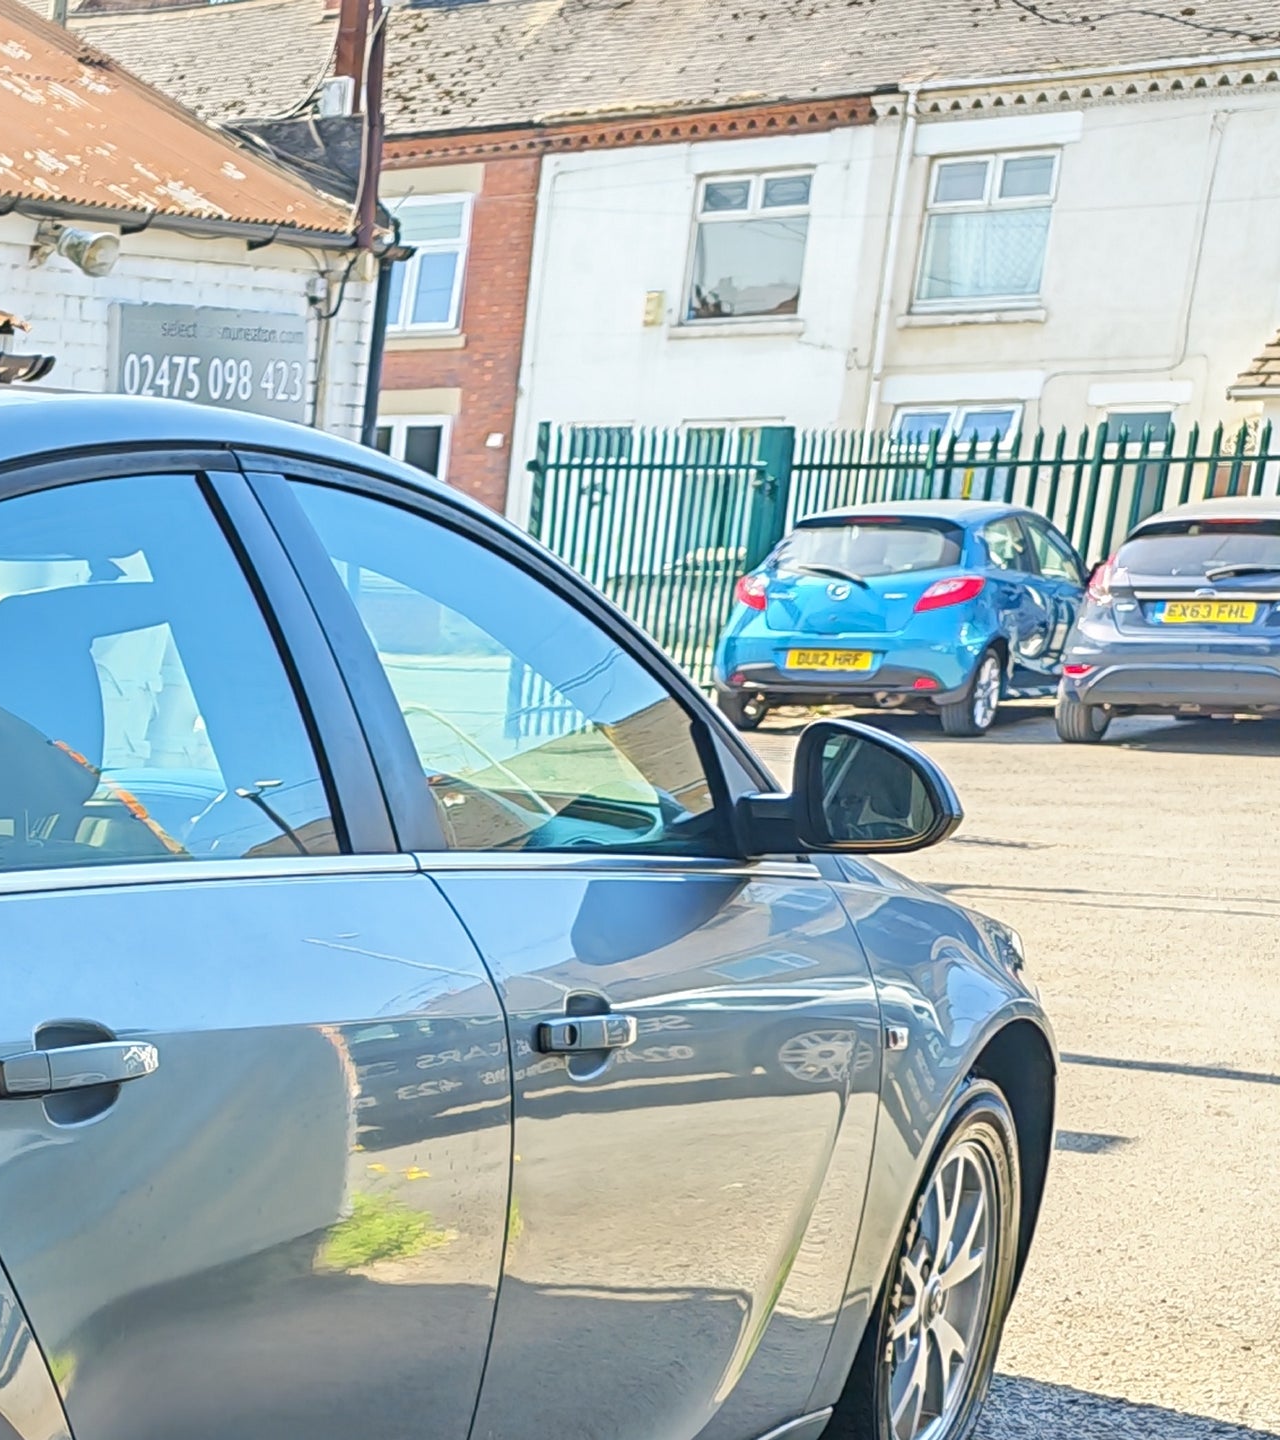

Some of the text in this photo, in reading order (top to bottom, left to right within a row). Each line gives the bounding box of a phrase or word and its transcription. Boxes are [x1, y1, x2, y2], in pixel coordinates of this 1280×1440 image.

[123, 352, 304, 401] 02475 098 423
[1167, 603, 1249, 619] EX63 FHL
[831, 652, 863, 667] HRF
